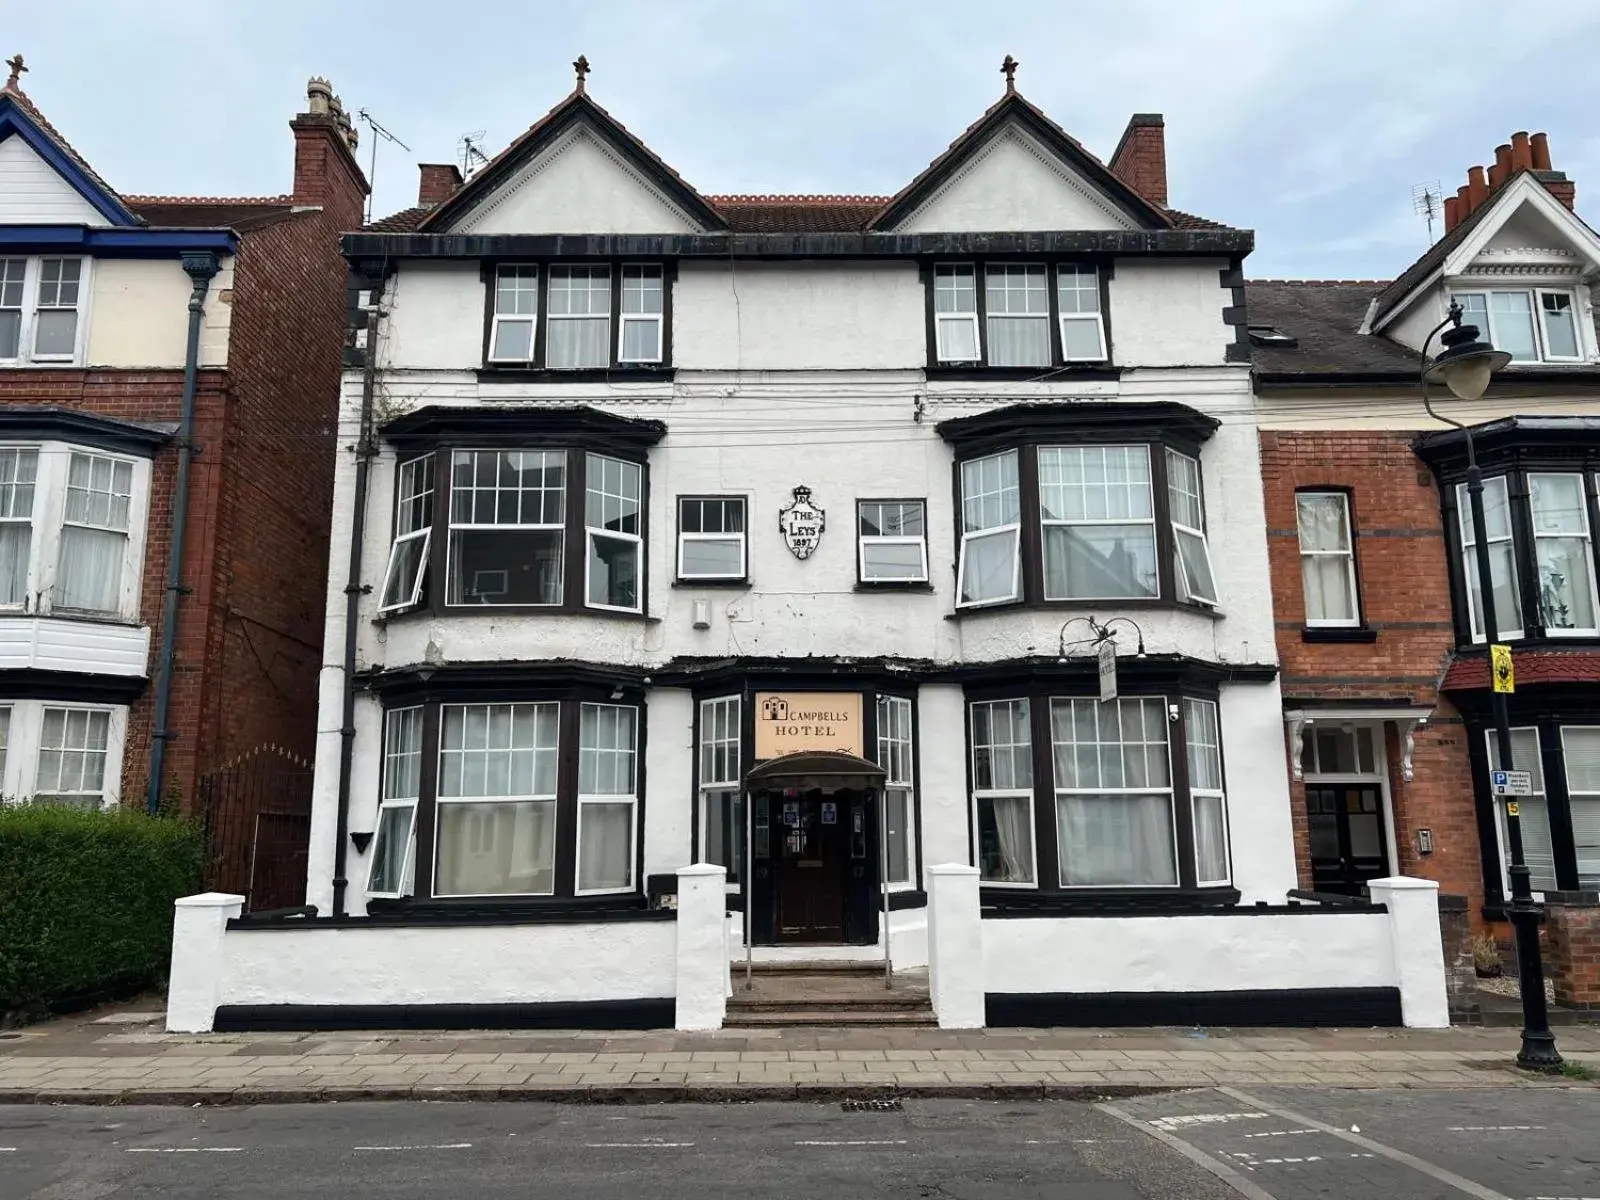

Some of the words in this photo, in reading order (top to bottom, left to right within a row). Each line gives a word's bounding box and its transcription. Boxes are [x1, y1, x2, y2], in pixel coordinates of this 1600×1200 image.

[791, 510, 813, 521] THE
[789, 523, 816, 537] LEYS
[792, 538, 812, 547] 1897
[789, 711, 849, 722] CAMPBELLS
[775, 726, 836, 736] HOTEL
[1496, 773, 1505, 784] P
[1509, 802, 1519, 814] 5
